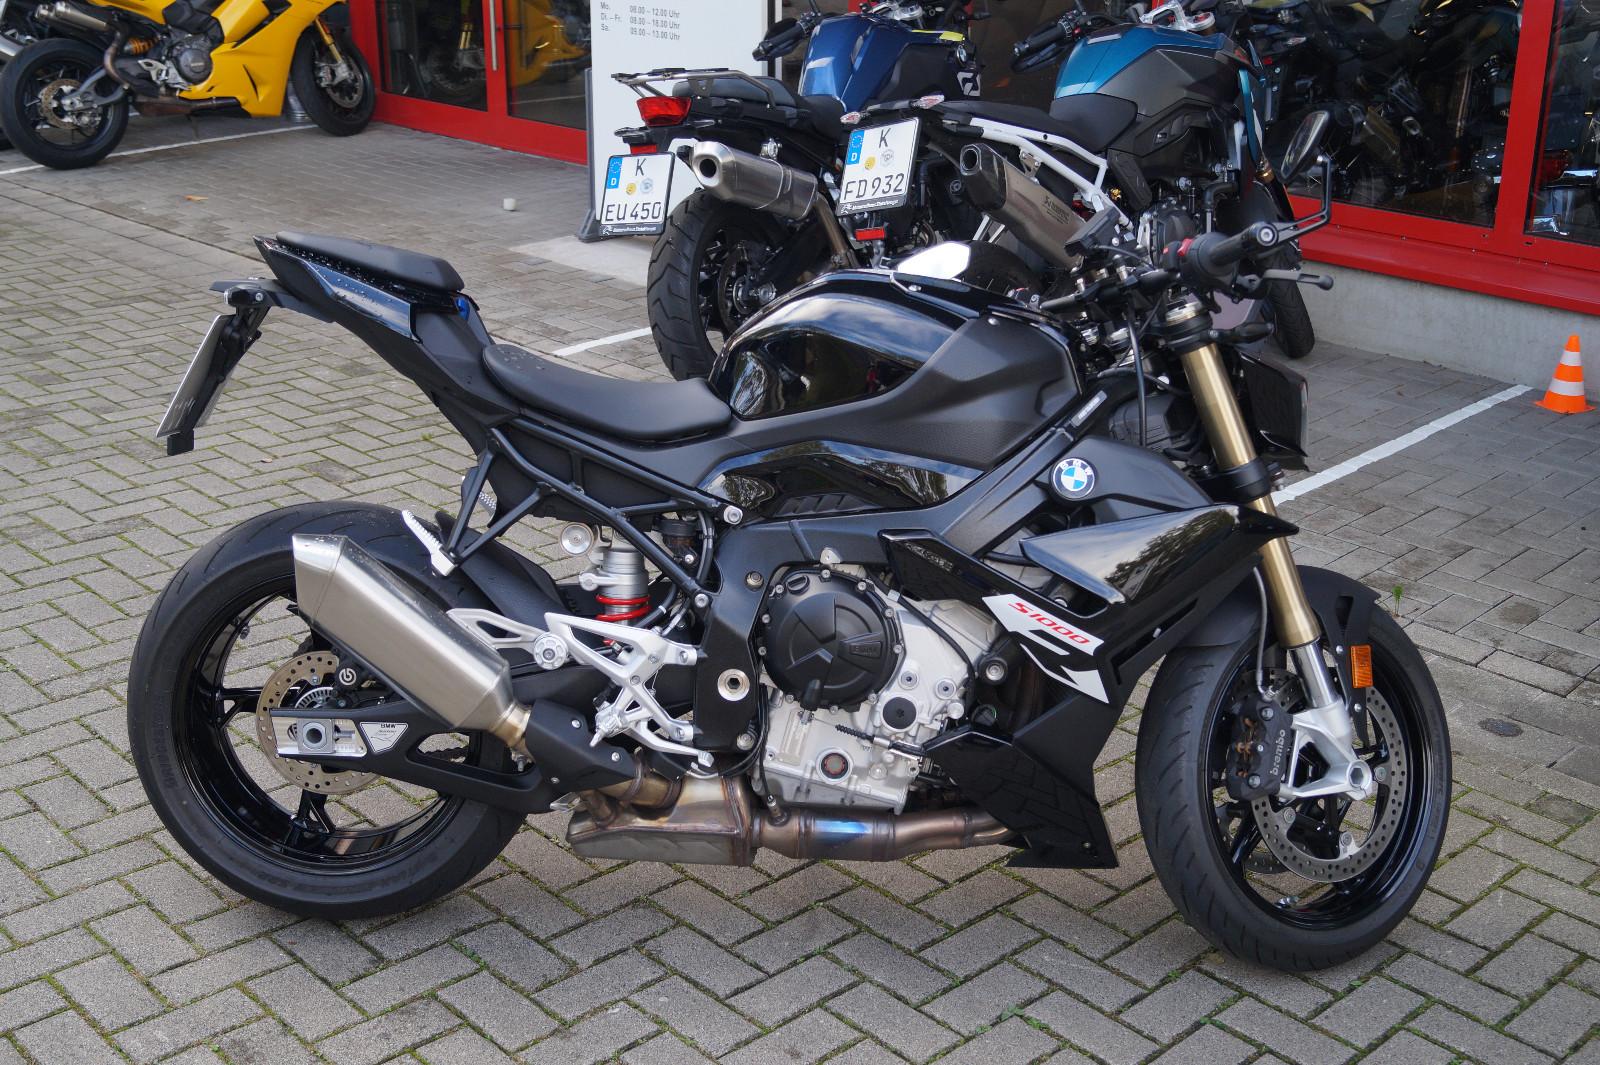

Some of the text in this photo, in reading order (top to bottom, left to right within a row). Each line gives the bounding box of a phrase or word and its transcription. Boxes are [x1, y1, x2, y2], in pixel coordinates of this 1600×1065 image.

[669, 9, 680, 18] Uhr
[669, 21, 680, 29] Uhr
[669, 31, 680, 40] Uhr
[878, 128, 891, 148] K
[851, 153, 858, 162] D
[635, 158, 647, 176] K
[610, 178, 617, 186] D
[871, 173, 905, 196] 932
[630, 201, 662, 220] 450
[1059, 459, 1093, 476] BMW
[1007, 602, 1091, 644] S1000
[1269, 729, 1286, 776] brembo
